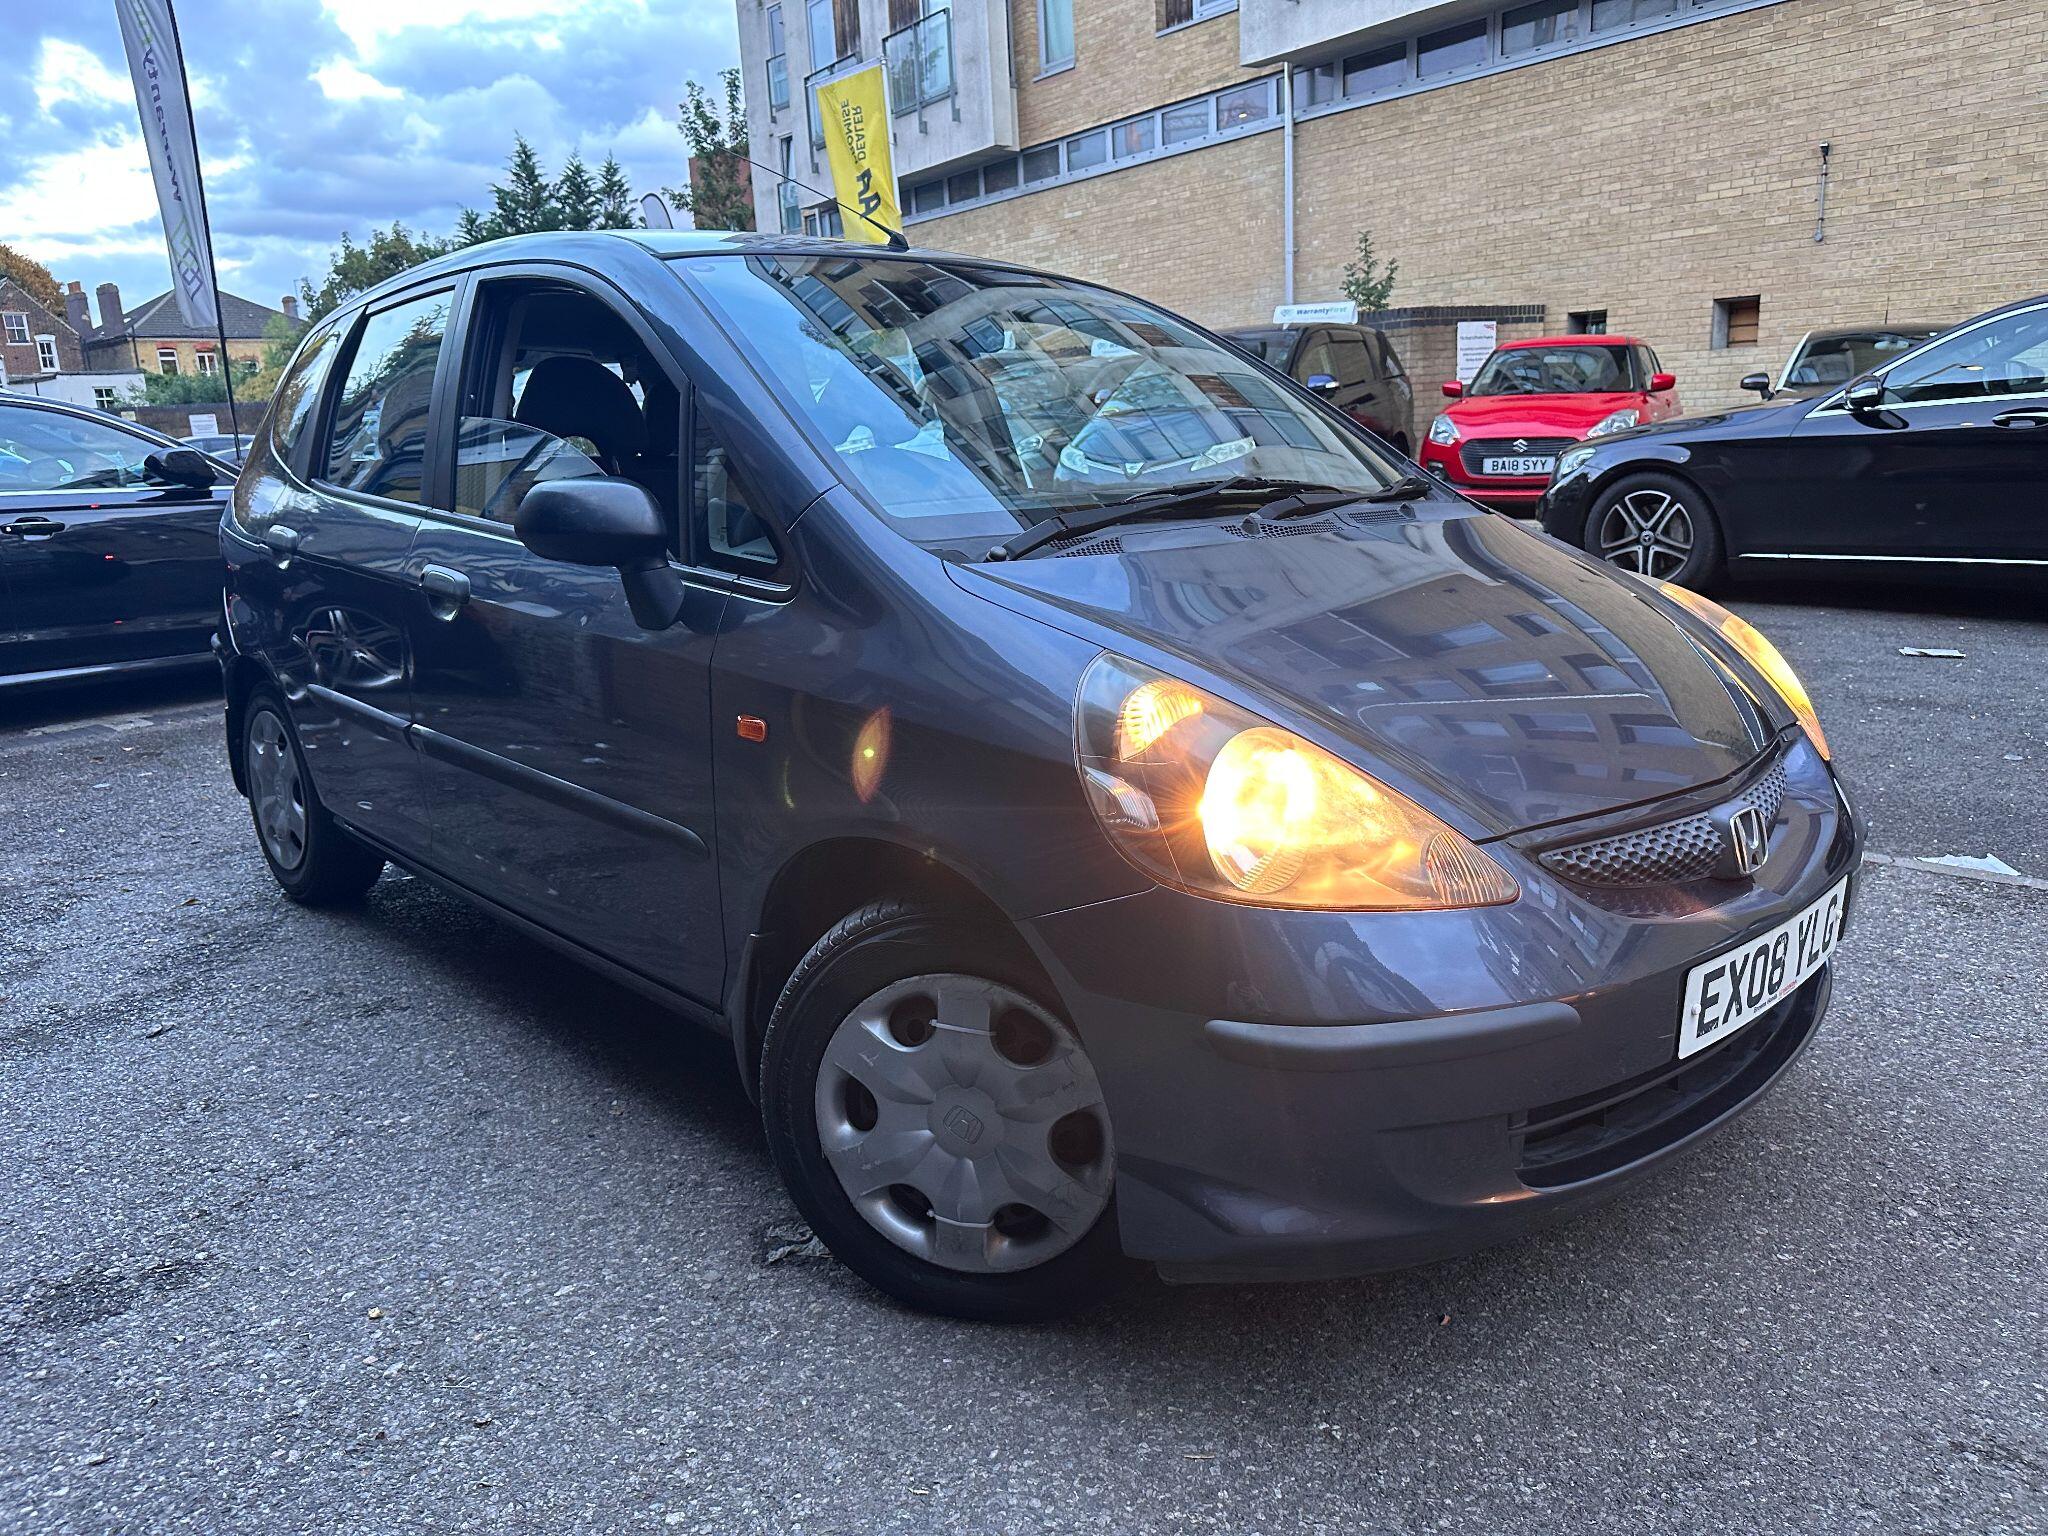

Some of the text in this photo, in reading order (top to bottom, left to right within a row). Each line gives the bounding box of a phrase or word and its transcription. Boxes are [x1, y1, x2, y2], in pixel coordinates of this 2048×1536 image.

[1491, 459, 1547, 471] BA18 SYY
[1696, 893, 1839, 1039] EX08 YLG
